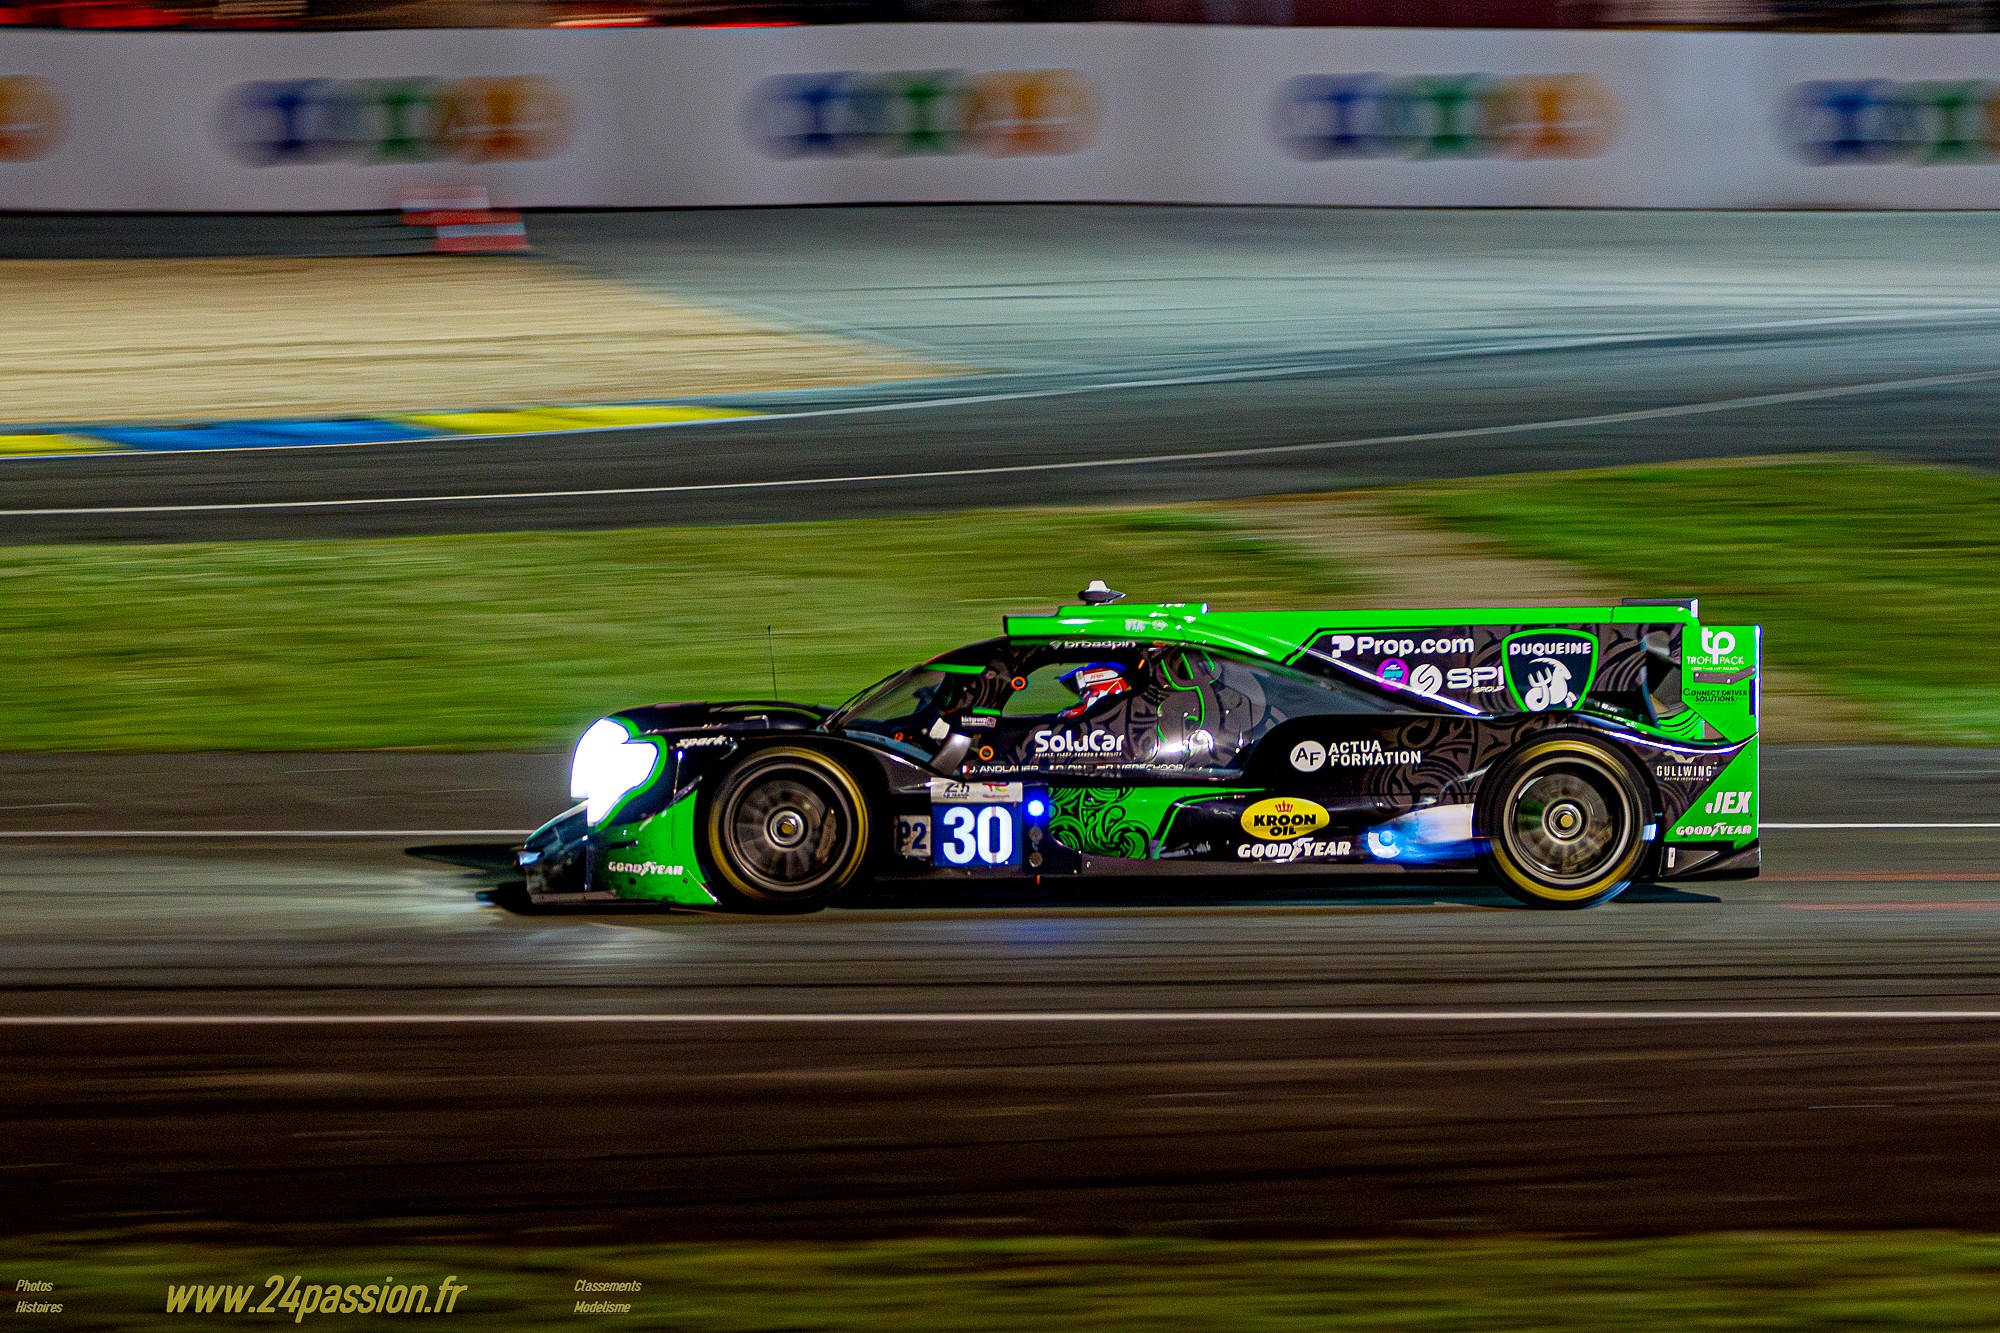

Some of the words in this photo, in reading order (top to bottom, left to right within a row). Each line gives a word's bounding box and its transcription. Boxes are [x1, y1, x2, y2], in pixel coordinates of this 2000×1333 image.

[1356, 636, 1475, 657] Prop.com
[1509, 642, 1592, 656] DUQUEINE
[1720, 656, 1744, 665] PACK
[1446, 665, 1505, 690] SPI
[1034, 729, 1125, 753] SoluCar
[1328, 740, 1382, 757] ACTUA
[1330, 751, 1422, 767] FORMATION
[1656, 765, 1713, 777] GULLWING
[1705, 792, 1752, 814] JEX
[1254, 814, 1317, 827] KROON
[943, 806, 1012, 864] 30
[1269, 826, 1297, 837] OIL
[1676, 822, 1753, 837] GOODYEAR
[1237, 838, 1352, 861] GOODYEAR
[608, 861, 684, 876] GOODYEAR
